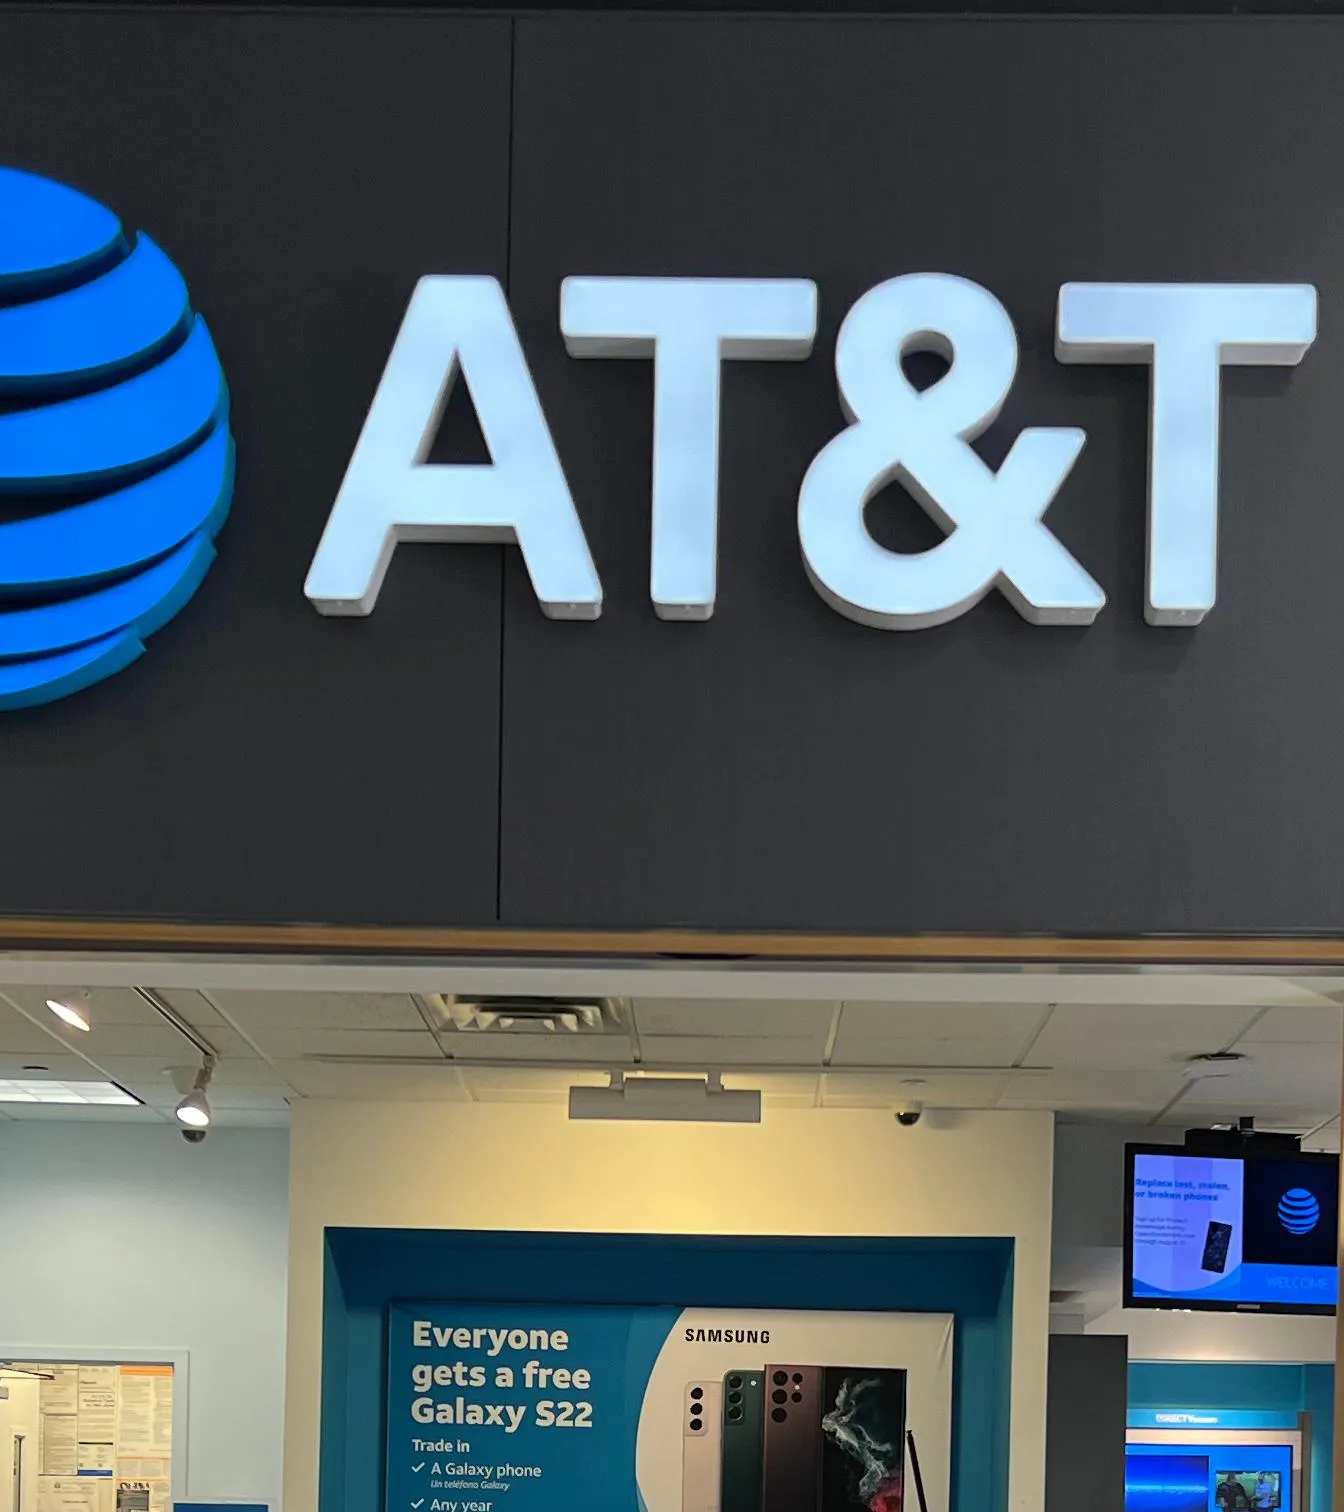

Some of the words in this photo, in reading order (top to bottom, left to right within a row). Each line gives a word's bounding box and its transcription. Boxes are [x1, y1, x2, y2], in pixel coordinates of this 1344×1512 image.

[303, 272, 1318, 630] AT&T
[1265, 1275, 1330, 1290] WELCOME
[413, 1320, 569, 1357] Everyone
[684, 1328, 771, 1345] SAMSUNG
[412, 1361, 486, 1393] gets
[495, 1366, 514, 1388] a
[522, 1360, 592, 1390] free
[411, 1397, 527, 1434] Galaxy
[535, 1400, 594, 1428] S22
[411, 1438, 453, 1452] Trade
[457, 1439, 470, 1453] in
[431, 1462, 442, 1475] A
[445, 1462, 493, 1478] Galaxy
[496, 1463, 542, 1478] phone
[480, 1481, 511, 1491] Galaxy
